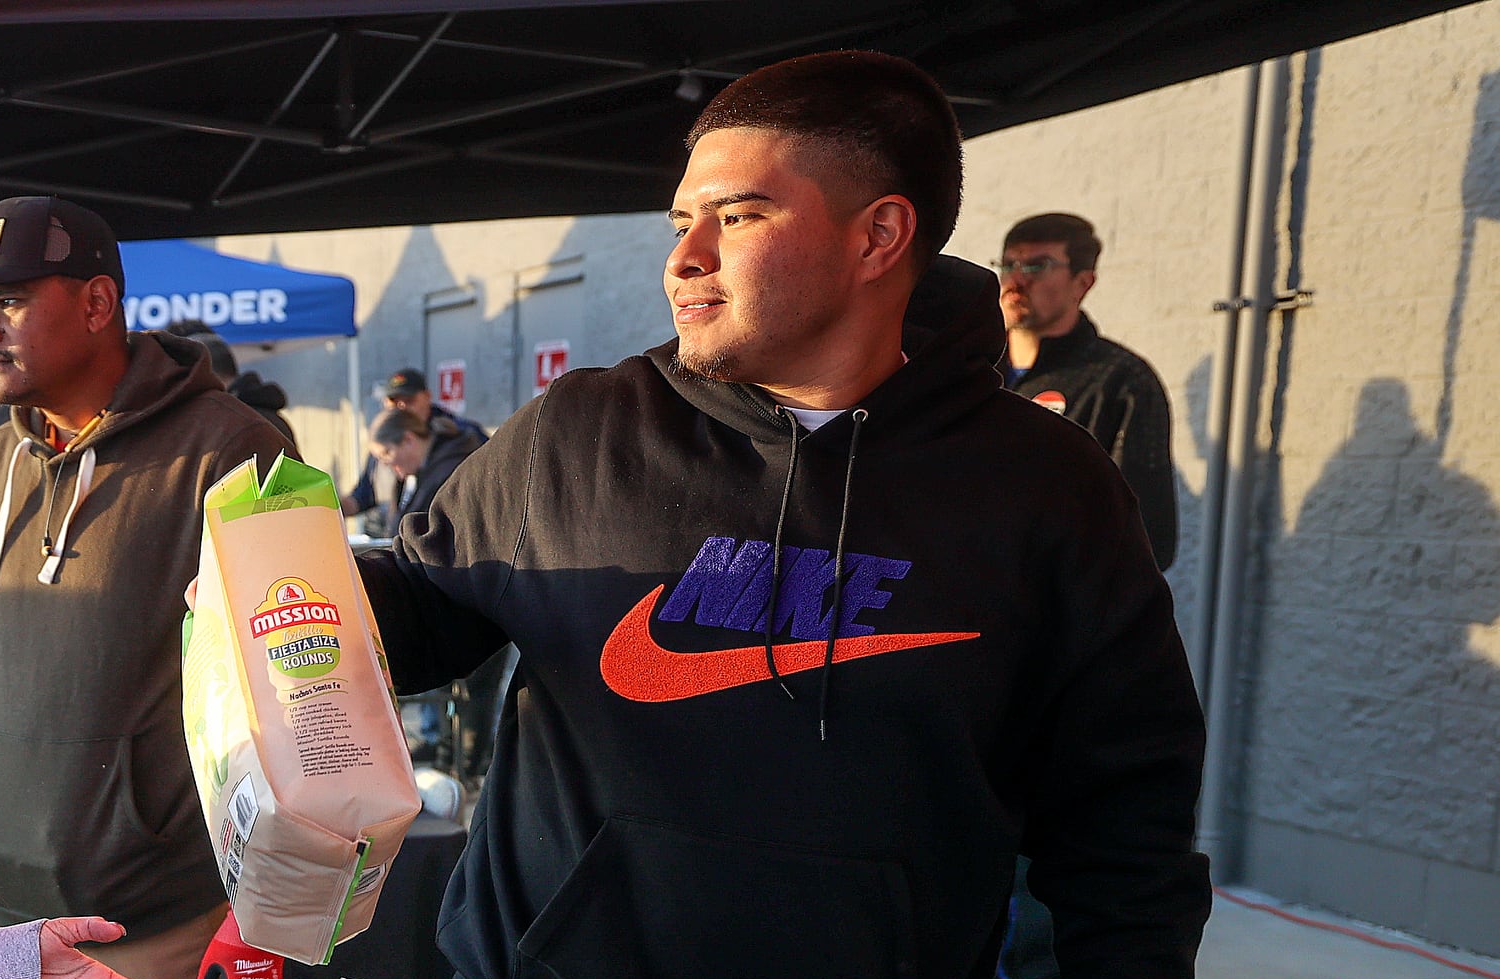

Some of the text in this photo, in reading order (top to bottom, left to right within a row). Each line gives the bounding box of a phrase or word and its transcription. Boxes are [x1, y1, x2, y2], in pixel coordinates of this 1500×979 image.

[658, 536, 912, 640] NIKE
[253, 605, 338, 634] MISSION
[271, 635, 337, 658] FIESTA SIZE
[282, 652, 334, 670] ROUNDS
[289, 681, 341, 701] Nachos Santa Fe
